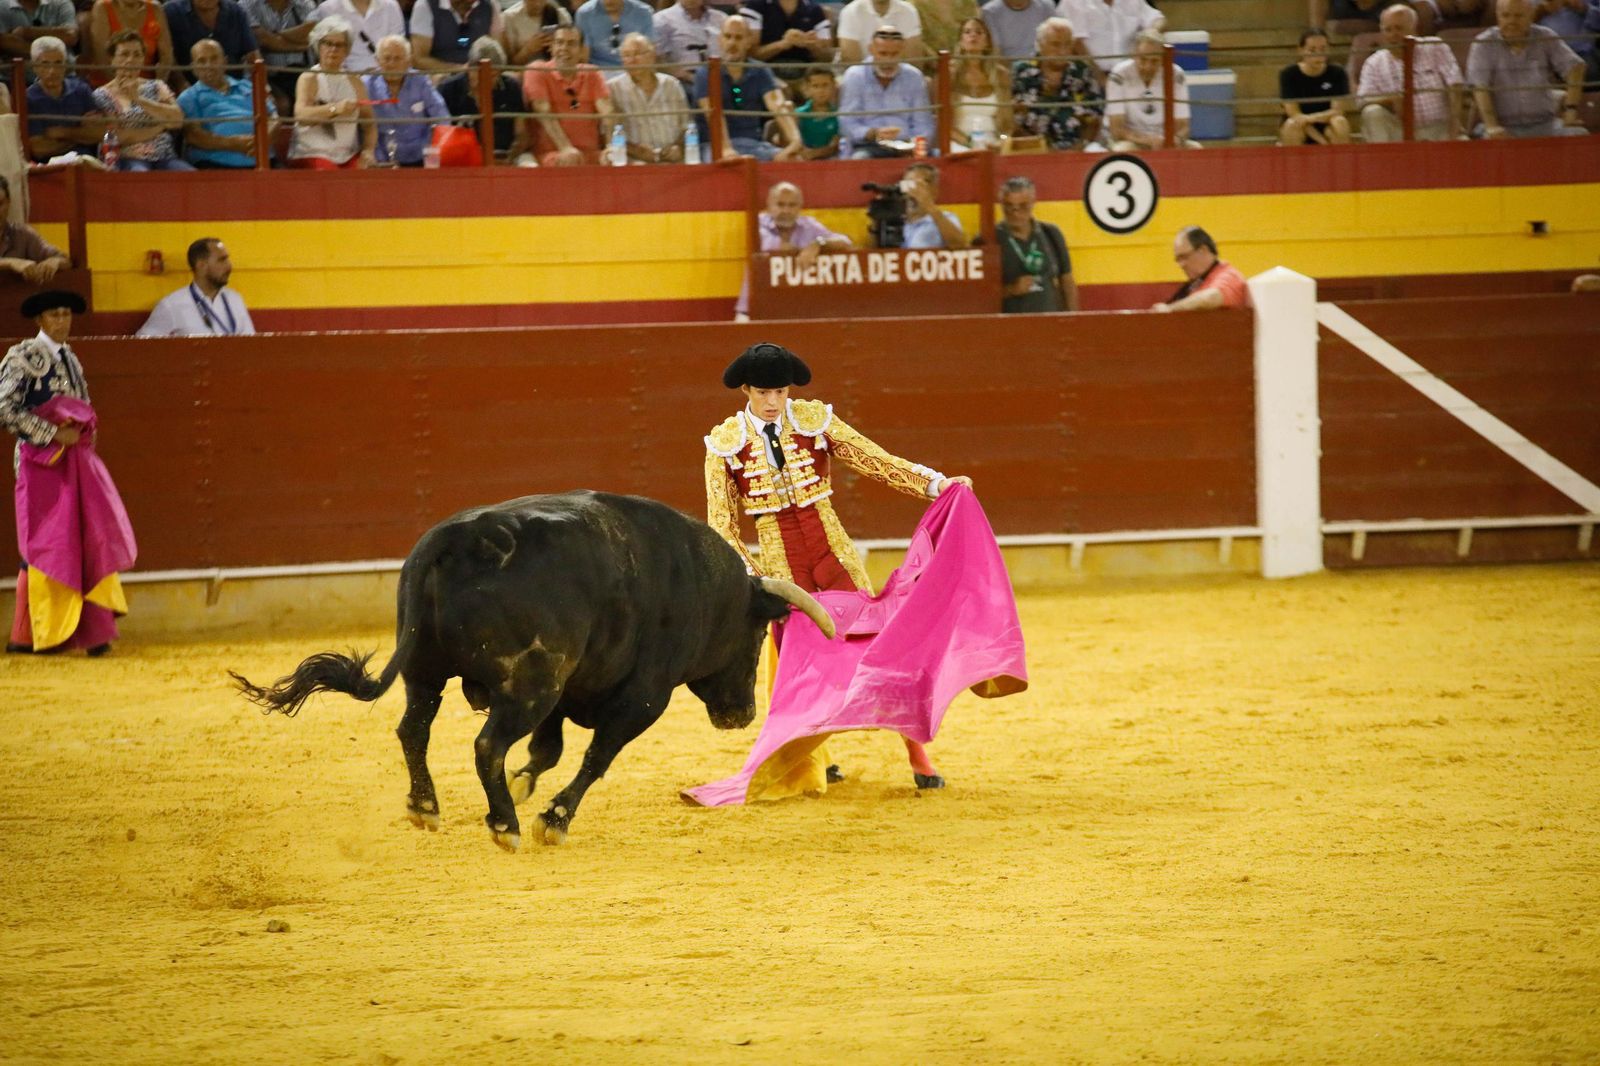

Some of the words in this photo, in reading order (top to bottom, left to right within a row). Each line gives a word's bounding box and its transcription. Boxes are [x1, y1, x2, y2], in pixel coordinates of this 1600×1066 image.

[1107, 170, 1135, 220] 3
[770, 254, 863, 287] PUERTA
[867, 252, 900, 283] DE
[904, 249, 984, 281] CORTE
